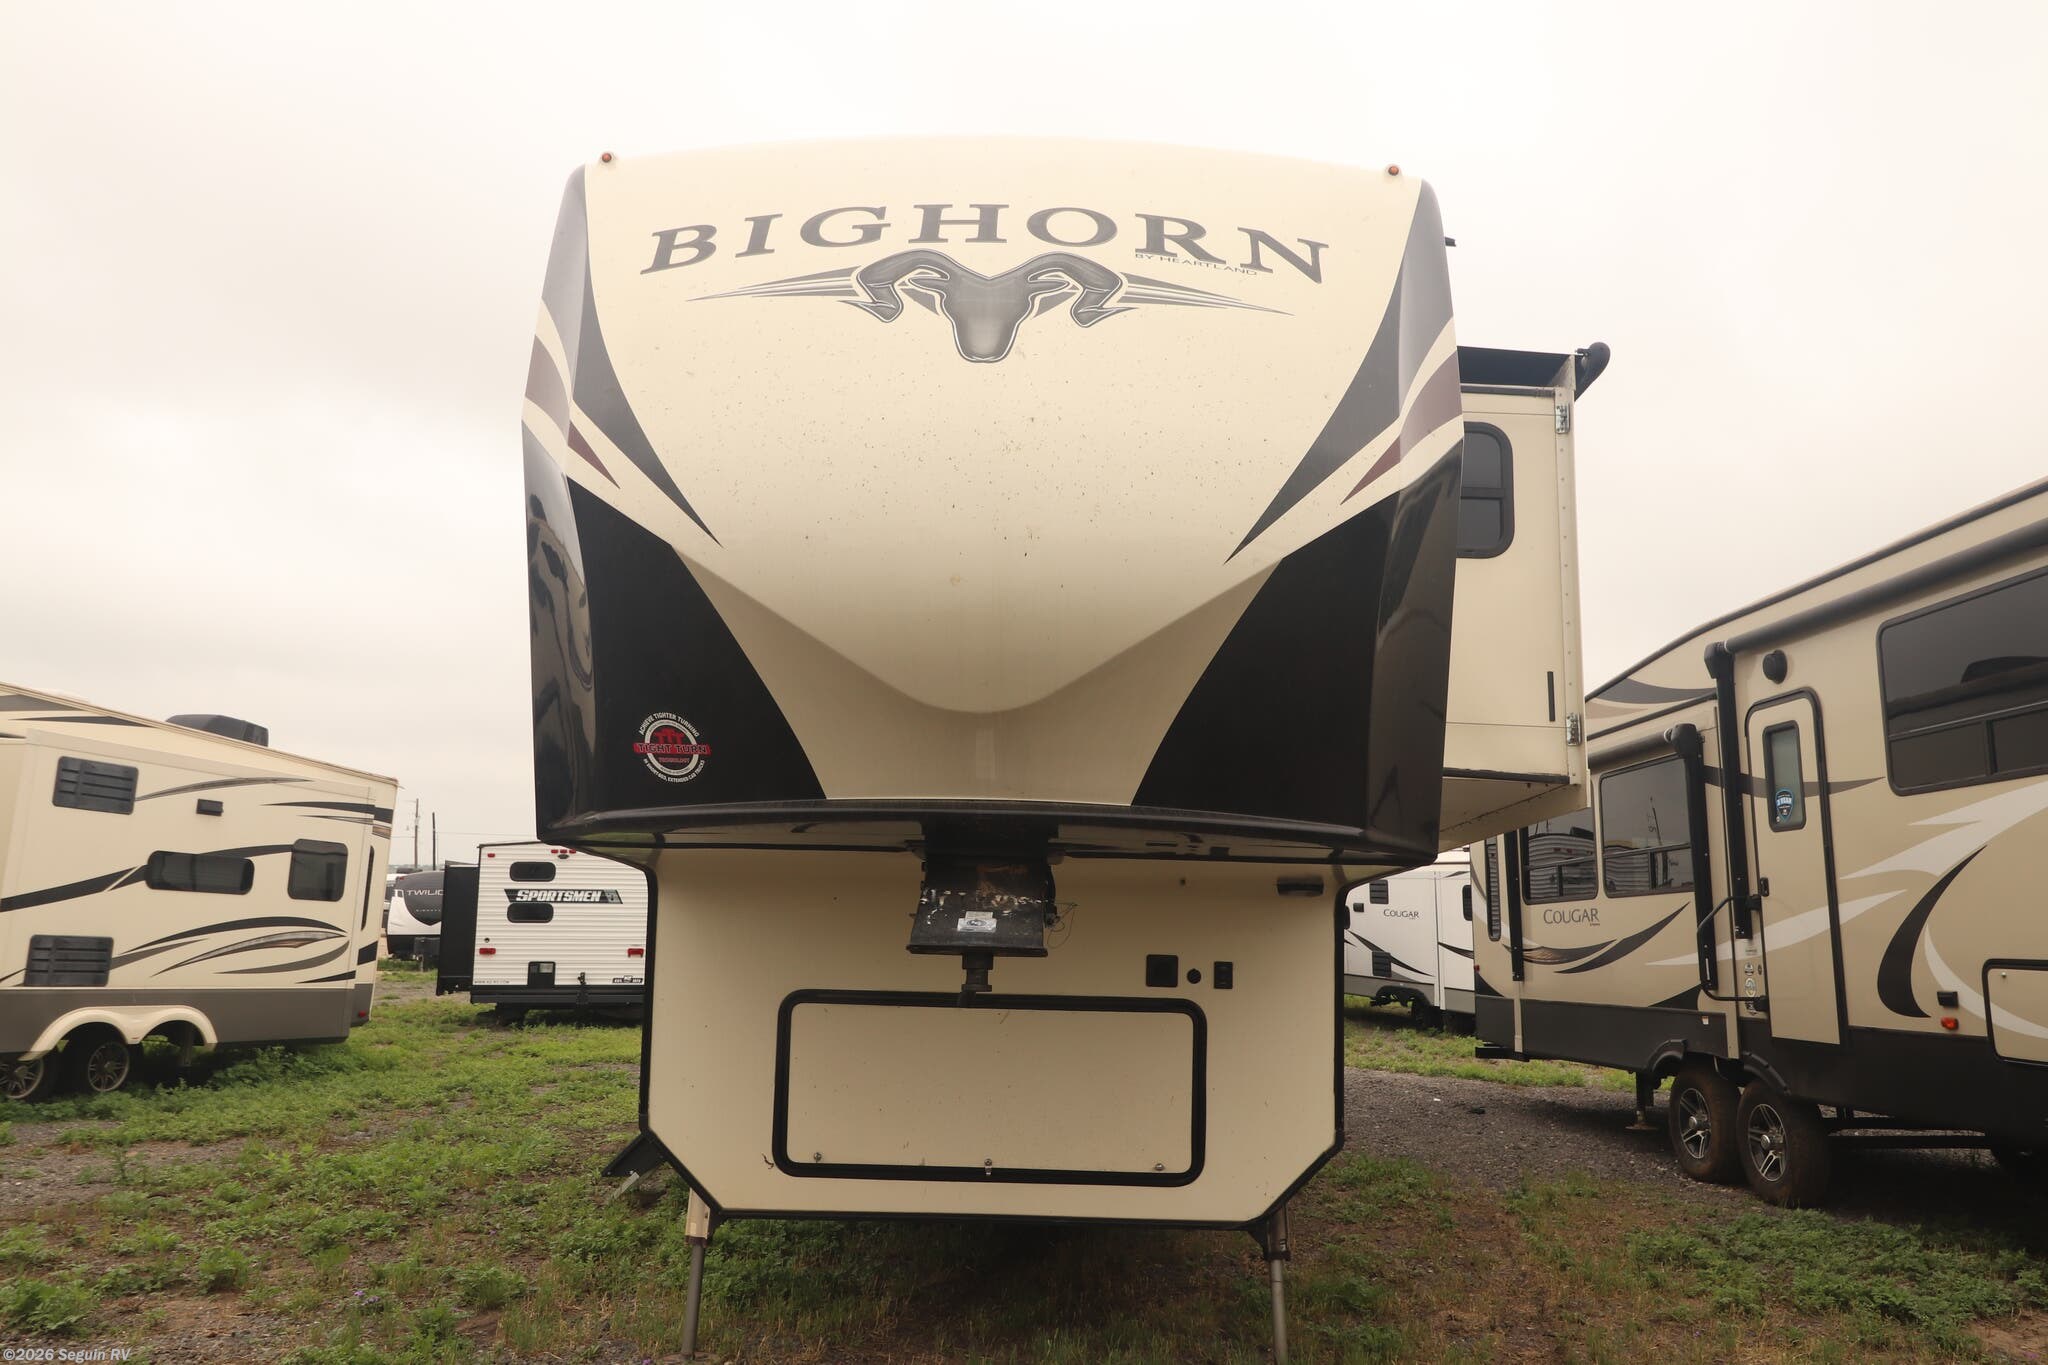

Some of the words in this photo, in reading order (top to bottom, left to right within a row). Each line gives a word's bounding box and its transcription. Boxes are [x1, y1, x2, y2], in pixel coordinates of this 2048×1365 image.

[640, 204, 1329, 284] BIGHORN
[1160, 256, 1257, 275] HEARTLAND
[678, 716, 700, 737] TURNING
[638, 743, 672, 753] TIGHT
[675, 744, 707, 754] TURN
[516, 889, 601, 902] SPORTSMEN
[1383, 909, 1419, 918] COUGAR
[1543, 908, 1600, 924] COUGAR
